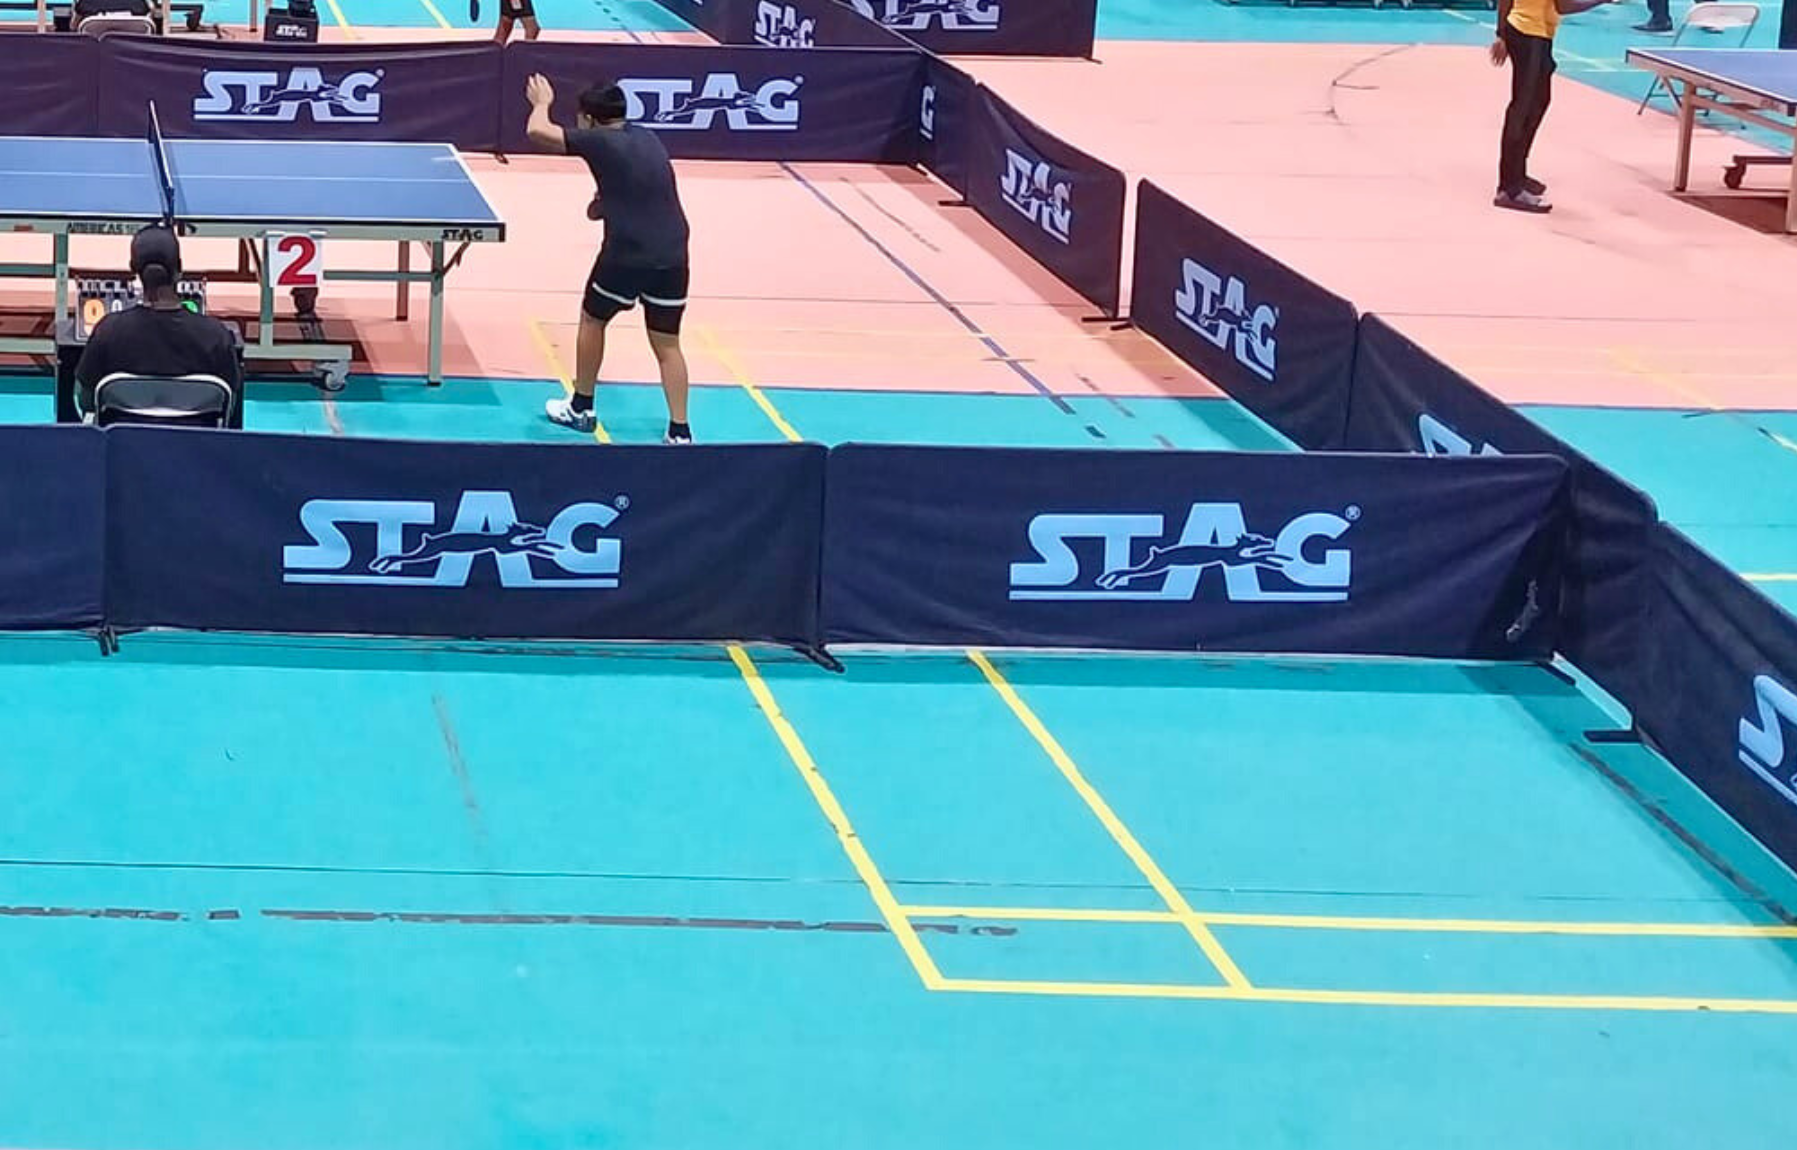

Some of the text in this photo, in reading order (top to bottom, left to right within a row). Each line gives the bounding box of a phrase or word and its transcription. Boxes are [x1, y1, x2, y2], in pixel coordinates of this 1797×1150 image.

[755, 0, 815, 48] STAG
[193, 67, 379, 123] STAG
[617, 73, 799, 130] STAG
[1001, 149, 1070, 244] STAG
[277, 235, 318, 286] 2
[442, 229, 483, 241] STAG
[1175, 257, 1277, 380] STAG
[283, 490, 621, 588] STAG
[1009, 502, 1350, 601] STAG
